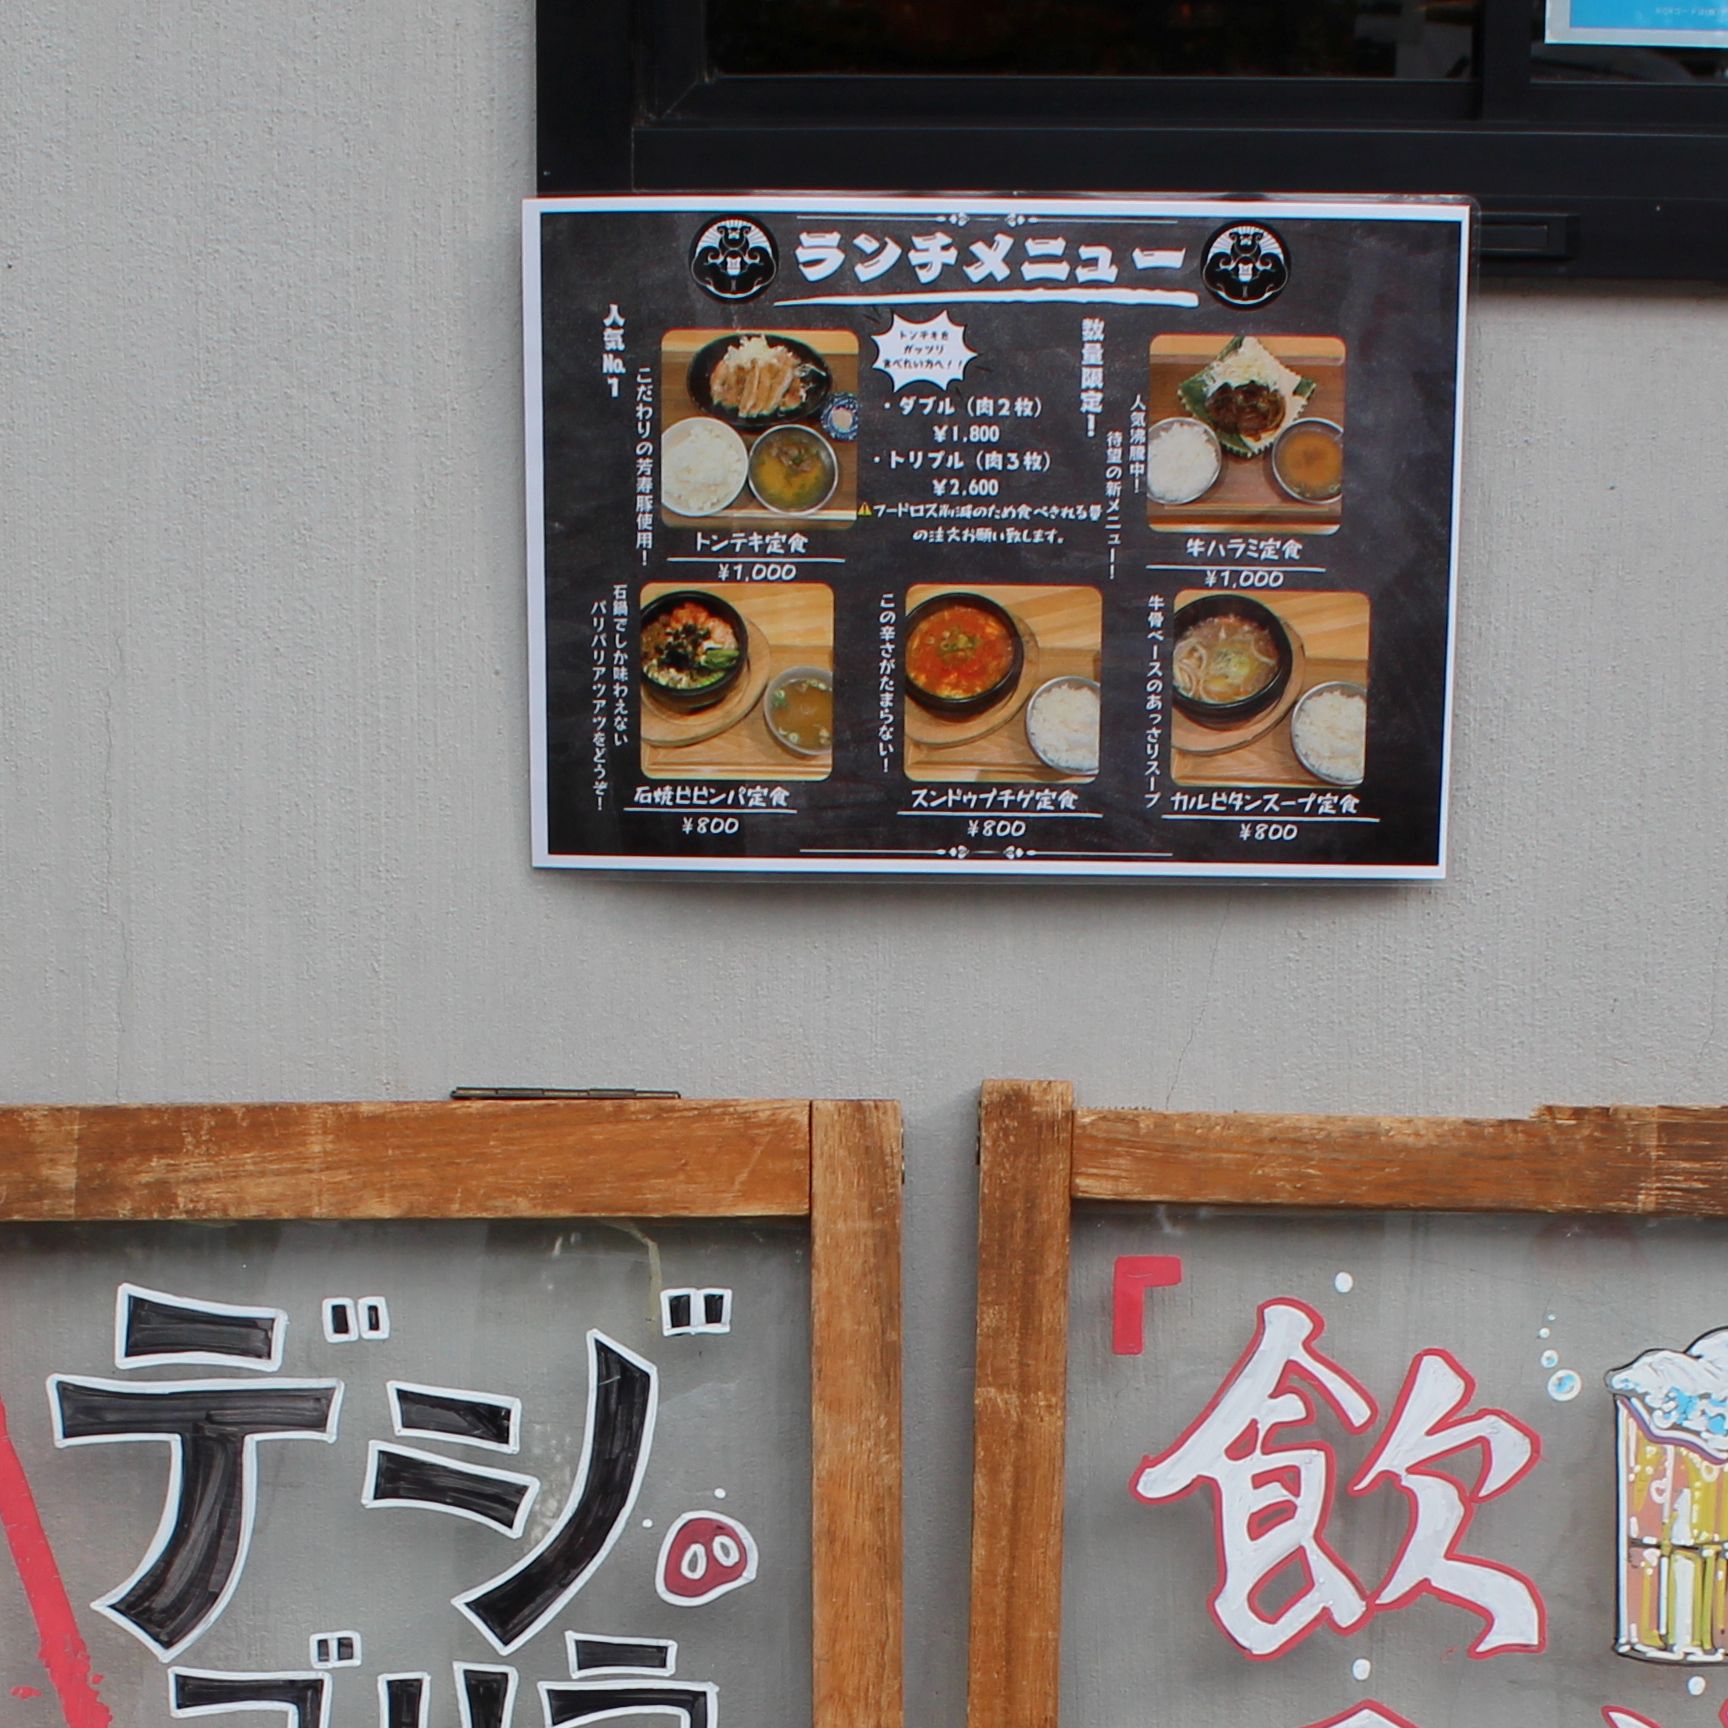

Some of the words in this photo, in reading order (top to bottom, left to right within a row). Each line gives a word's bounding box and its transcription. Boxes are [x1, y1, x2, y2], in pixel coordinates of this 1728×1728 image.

[793, 231, 1187, 284] ランチメニュー
[1080, 318, 1105, 438] 数量限定!
[933, 425, 1001, 444] ¥1,800
[932, 478, 1000, 497] ¥2,600
[695, 532, 809, 555] トンテキ定食
[1186, 537, 1303, 560] 牛ハラミ定食
[718, 563, 797, 583] ¥1,000
[1204, 570, 1285, 589] ¥1,000
[612, 584, 629, 747] 石鍋でしか味わえない
[878, 593, 897, 774] この辛さがたまらない!
[1144, 595, 1165, 809] 牛骨ベースのあっさりスープ
[1169, 791, 1361, 815] カルビタンスープ定食
[682, 817, 740, 835] ¥800
[967, 820, 1027, 838] ¥800
[1238, 823, 1299, 841] ¥800
[48, 1282, 733, 1655] デジ
